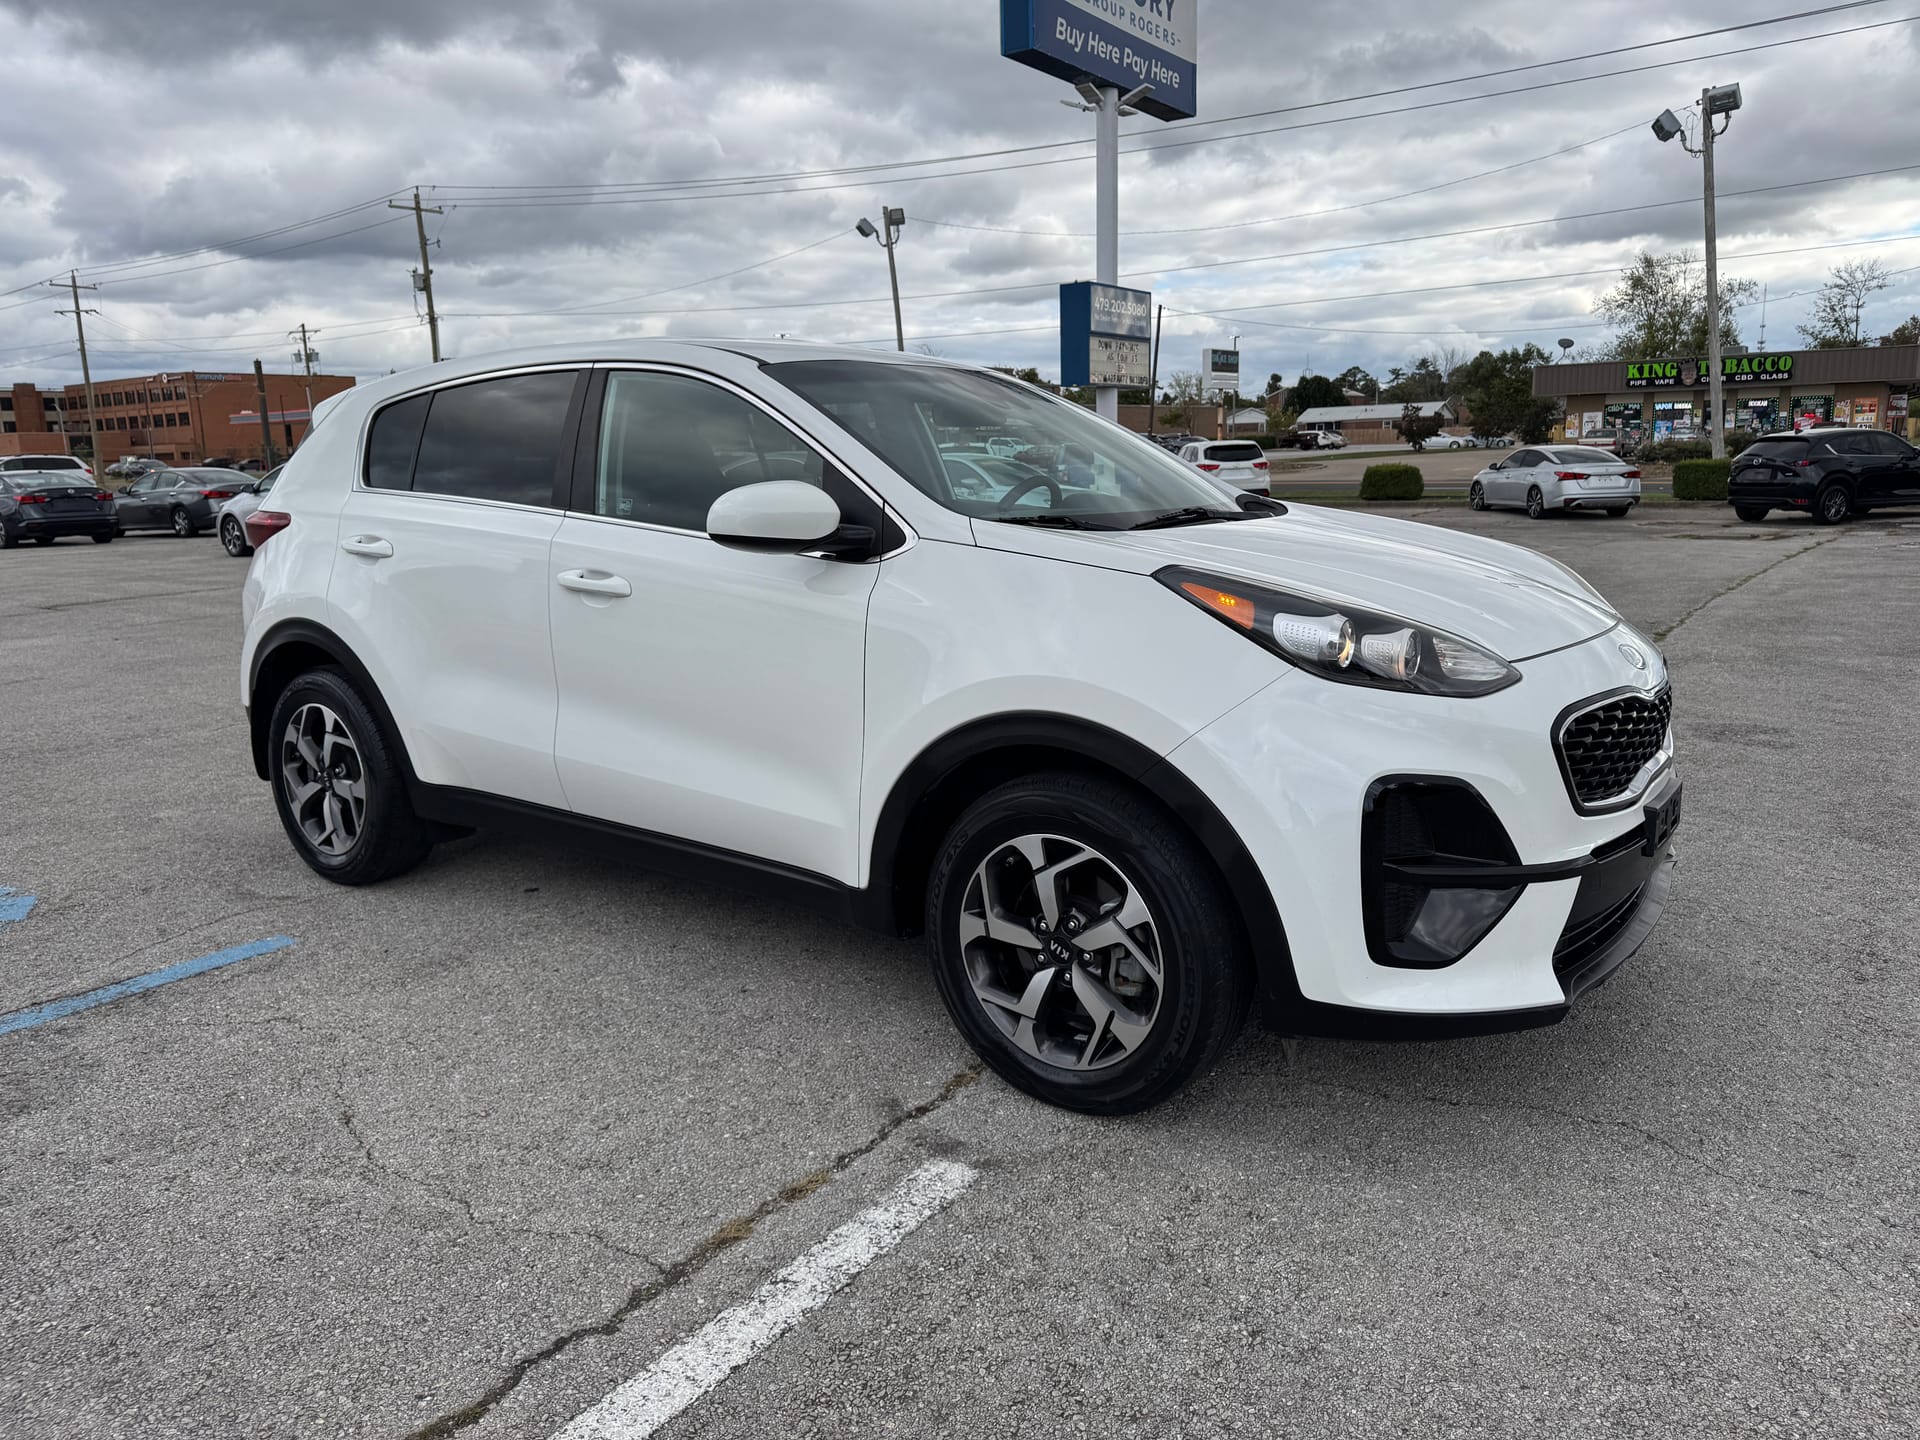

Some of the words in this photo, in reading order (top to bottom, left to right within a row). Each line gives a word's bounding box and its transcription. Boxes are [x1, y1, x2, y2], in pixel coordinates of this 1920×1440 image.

[1130, 11, 1176, 46] ROGERS
[1055, 17, 1085, 54] Buy
[1088, 31, 1120, 64] Here
[1123, 47, 1149, 79] Pay
[1151, 59, 1180, 89] Here
[1094, 296, 1147, 317] 479.202.5080
[1627, 361, 1678, 379] KING
[1698, 355, 1793, 376] TBACCO
[1629, 379, 1647, 387] PIPE
[1654, 378, 1675, 386] VAPE
[1701, 375, 1726, 383] CIR
[1735, 374, 1753, 382] CBD
[1760, 372, 1789, 380] GLASS
[1050, 939, 1070, 961] KIA
